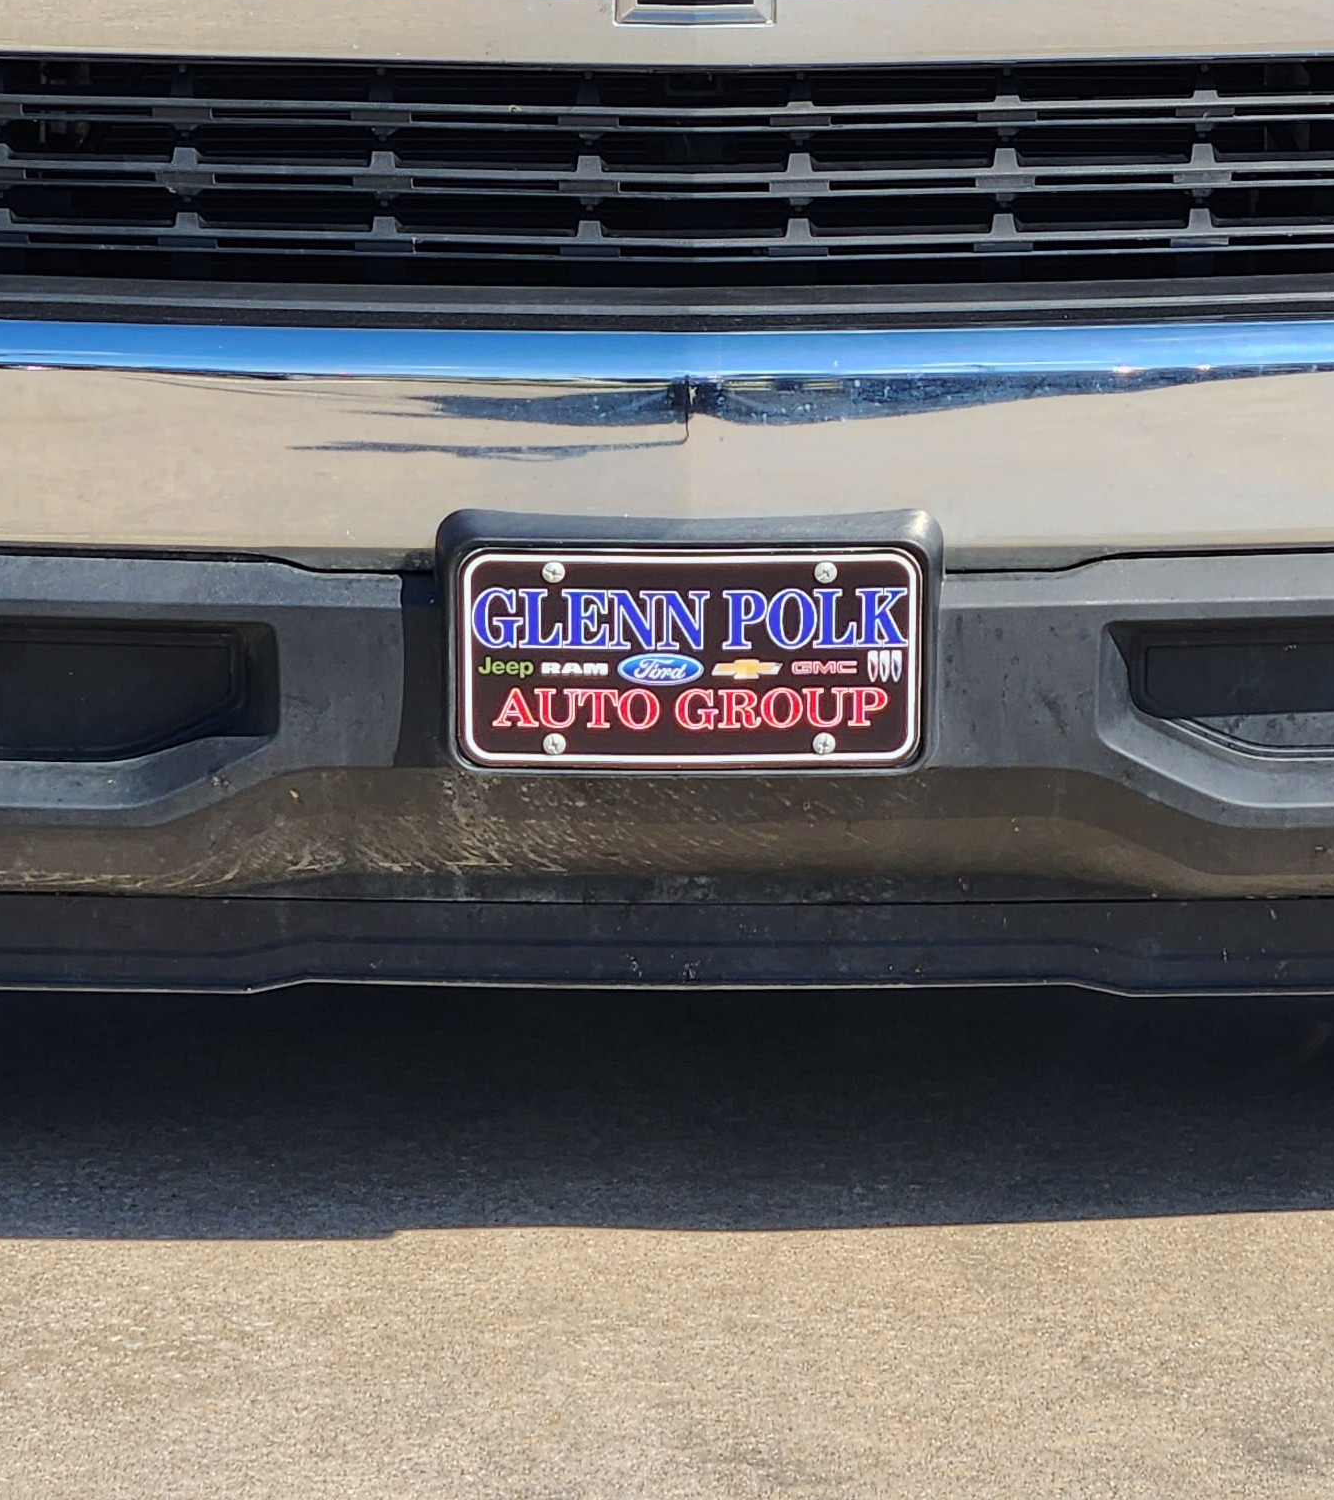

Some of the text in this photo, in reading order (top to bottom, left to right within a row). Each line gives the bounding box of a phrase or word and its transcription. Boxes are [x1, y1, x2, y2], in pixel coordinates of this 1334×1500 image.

[471, 586, 909, 652] GLENN POLK
[477, 655, 535, 679] Jeep
[540, 661, 609, 677] RAM
[790, 659, 859, 676] GMC
[492, 686, 889, 731] AUTO GROUP
